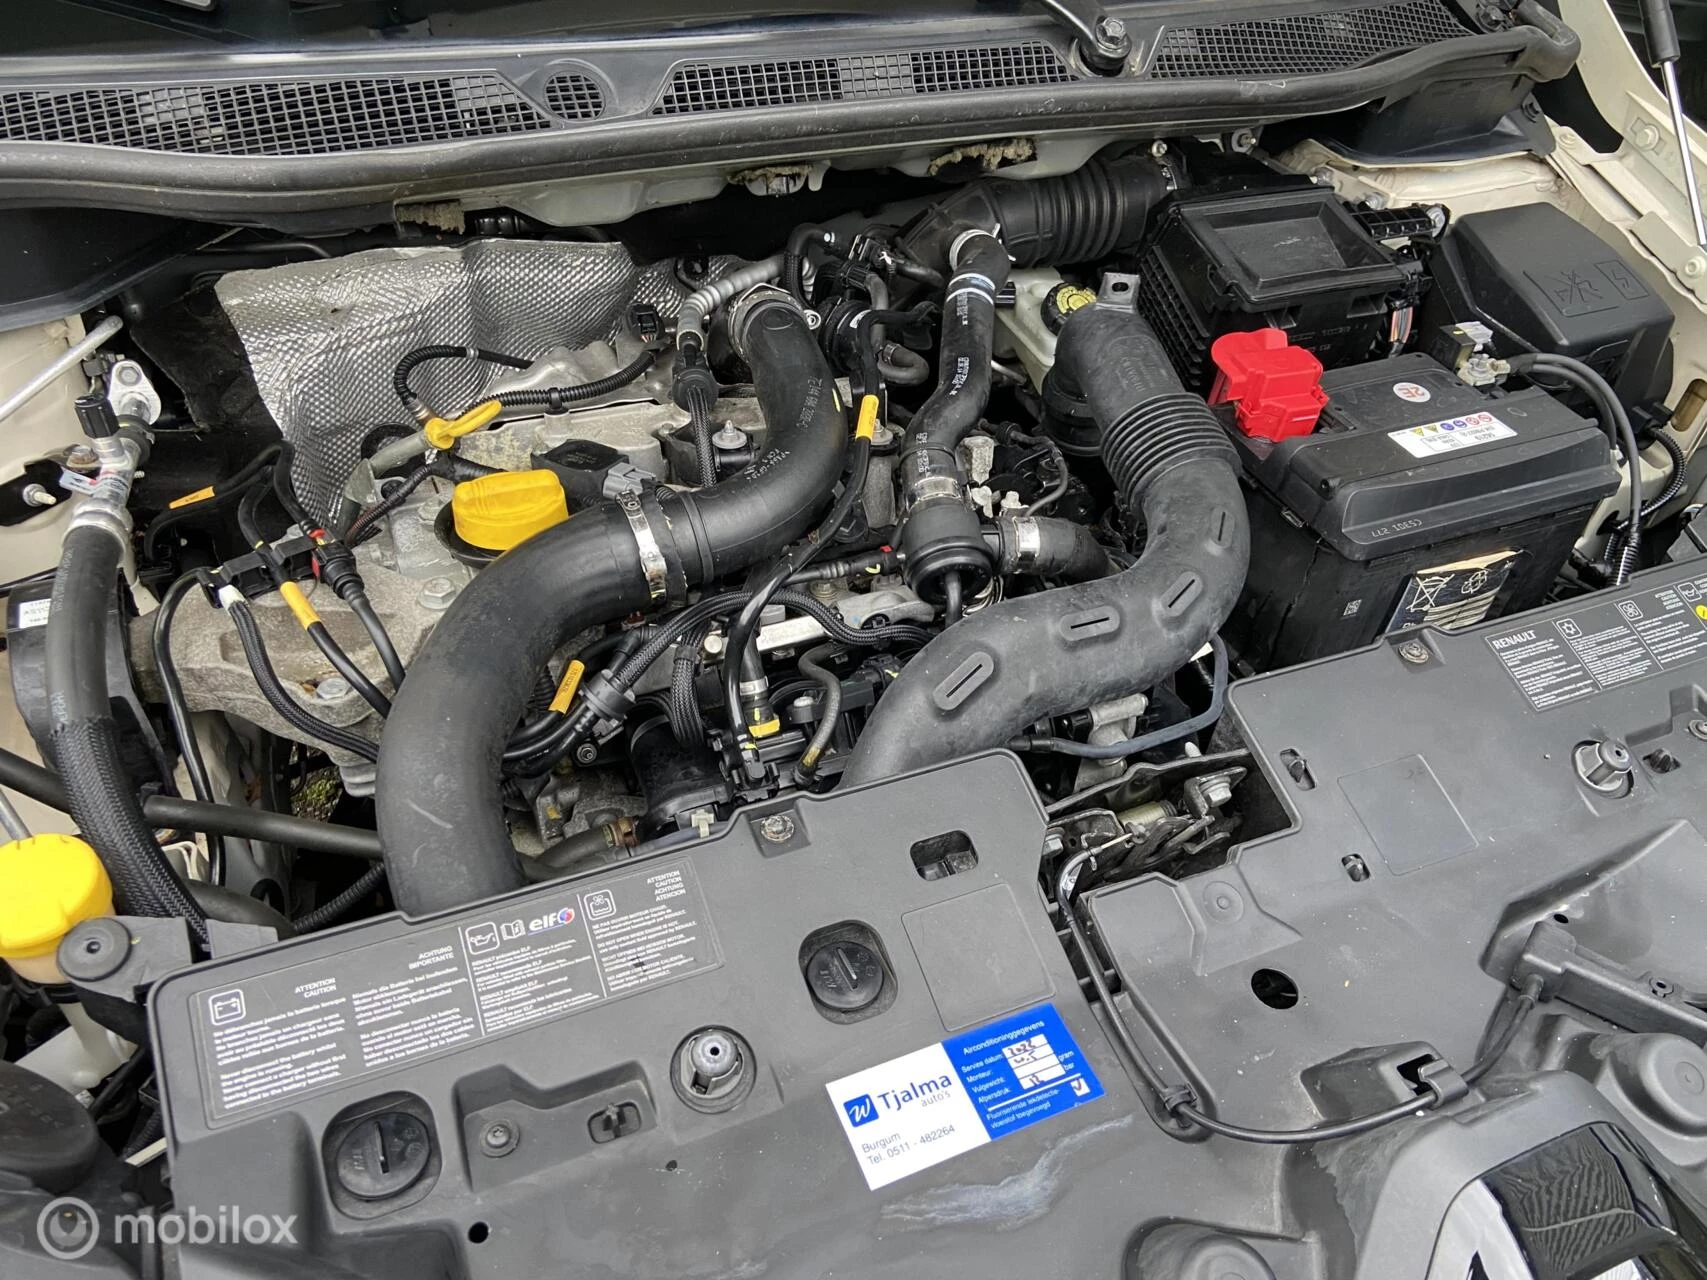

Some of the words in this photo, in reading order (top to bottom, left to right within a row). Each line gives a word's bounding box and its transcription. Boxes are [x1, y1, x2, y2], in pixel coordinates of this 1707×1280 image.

[1492, 630, 1536, 649] RENAULT
[647, 870, 680, 883] ATTENTION
[655, 876, 682, 887] CAUTION
[655, 882, 683, 895] ACHTUNG
[528, 912, 558, 933] elf
[409, 952, 454, 969] IMPORTANTE
[418, 946, 452, 959] ACHTUNG
[295, 977, 335, 993] ATTENTION
[304, 985, 336, 998] CAUTION
[963, 1021, 1045, 1055] Airconditioninggegevens
[1058, 1051, 1074, 1061] gram
[961, 1061, 984, 1073] Service
[877, 1075, 952, 1110] Tjalma
[921, 1090, 950, 1107] auto's
[861, 1133, 900, 1153] Burgum
[867, 1153, 882, 1164] Tel.
[886, 1142, 910, 1158] 0511
[920, 1124, 955, 1144] 482264
